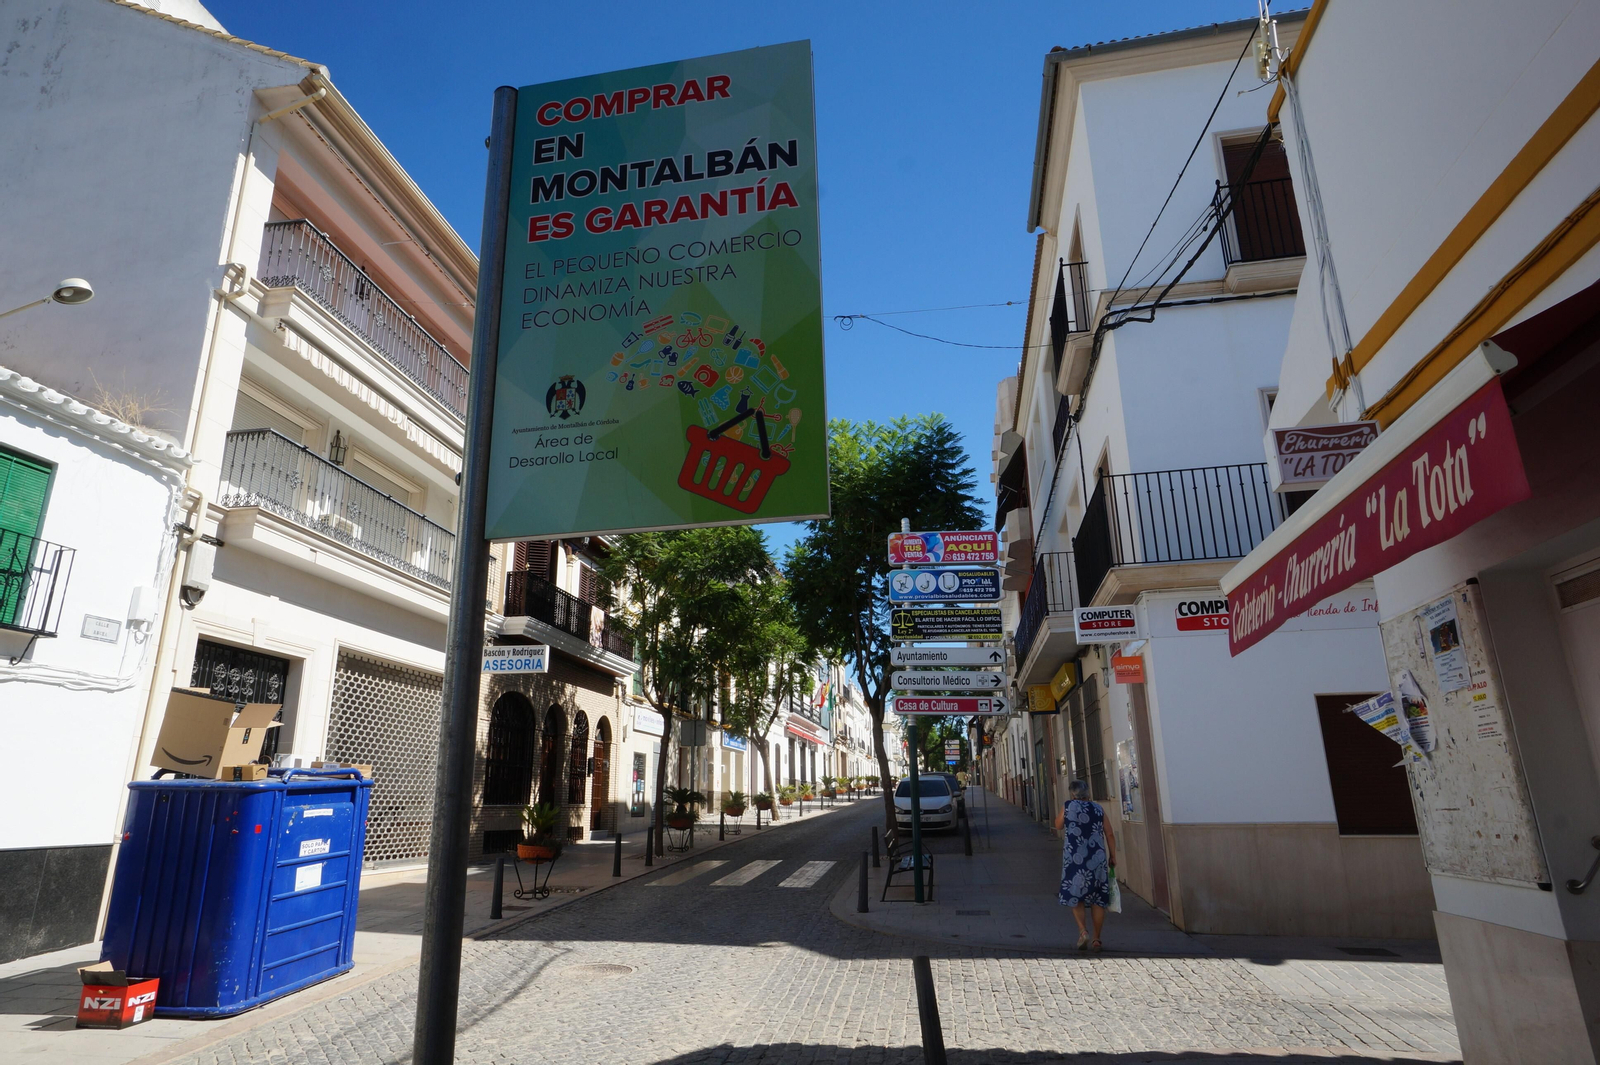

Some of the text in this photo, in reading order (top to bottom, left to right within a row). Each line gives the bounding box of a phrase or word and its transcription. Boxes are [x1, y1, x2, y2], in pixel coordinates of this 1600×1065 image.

[536, 75, 731, 127] COMPRAR
[533, 132, 585, 165] EN
[530, 137, 799, 204] MONTALBÁN
[527, 177, 800, 243] ES GARANTÍA
[525, 229, 802, 280] EL PEQUEÑO COMERCIO
[523, 263, 737, 304] DINAMIZA NUESTRA
[521, 296, 651, 330] ECONOMÍA
[512, 426, 550, 434] Ayuntamiento
[558, 422, 588, 430] Montalbán
[596, 418, 620, 426] Córdoba
[534, 433, 593, 449] Área de
[509, 447, 618, 468] Desarollo Local
[944, 534, 993, 542] ANÚNCIATE
[946, 541, 992, 552] AQUÍ
[1232, 574, 1276, 644] Cafetería
[1344, 601, 1357, 612] de
[1081, 610, 1132, 620] COMPUTER
[484, 647, 544, 658] Bascón y Rodríguez
[897, 651, 947, 662] Ayuntamiento
[483, 659, 543, 671] ASESORIA
[898, 675, 970, 685] Consultorio Médico
[898, 700, 958, 710] Casa de Cultura
